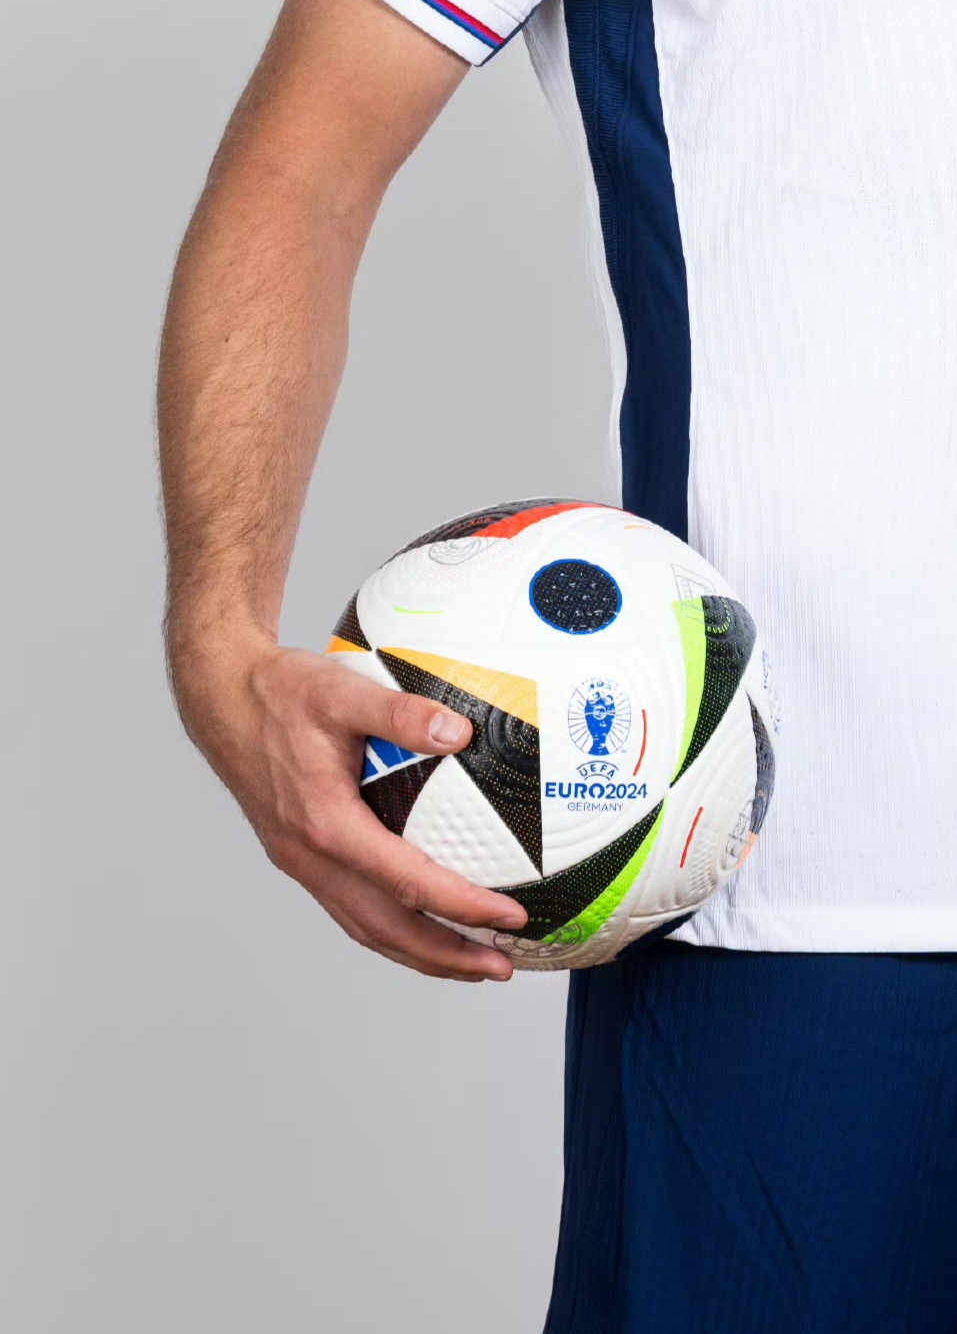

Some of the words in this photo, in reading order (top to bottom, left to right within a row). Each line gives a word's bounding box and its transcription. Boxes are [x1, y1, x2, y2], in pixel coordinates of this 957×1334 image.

[579, 764, 615, 778] UEFA
[545, 782, 648, 799] EURO2024
[567, 802, 624, 812] GERMANY
